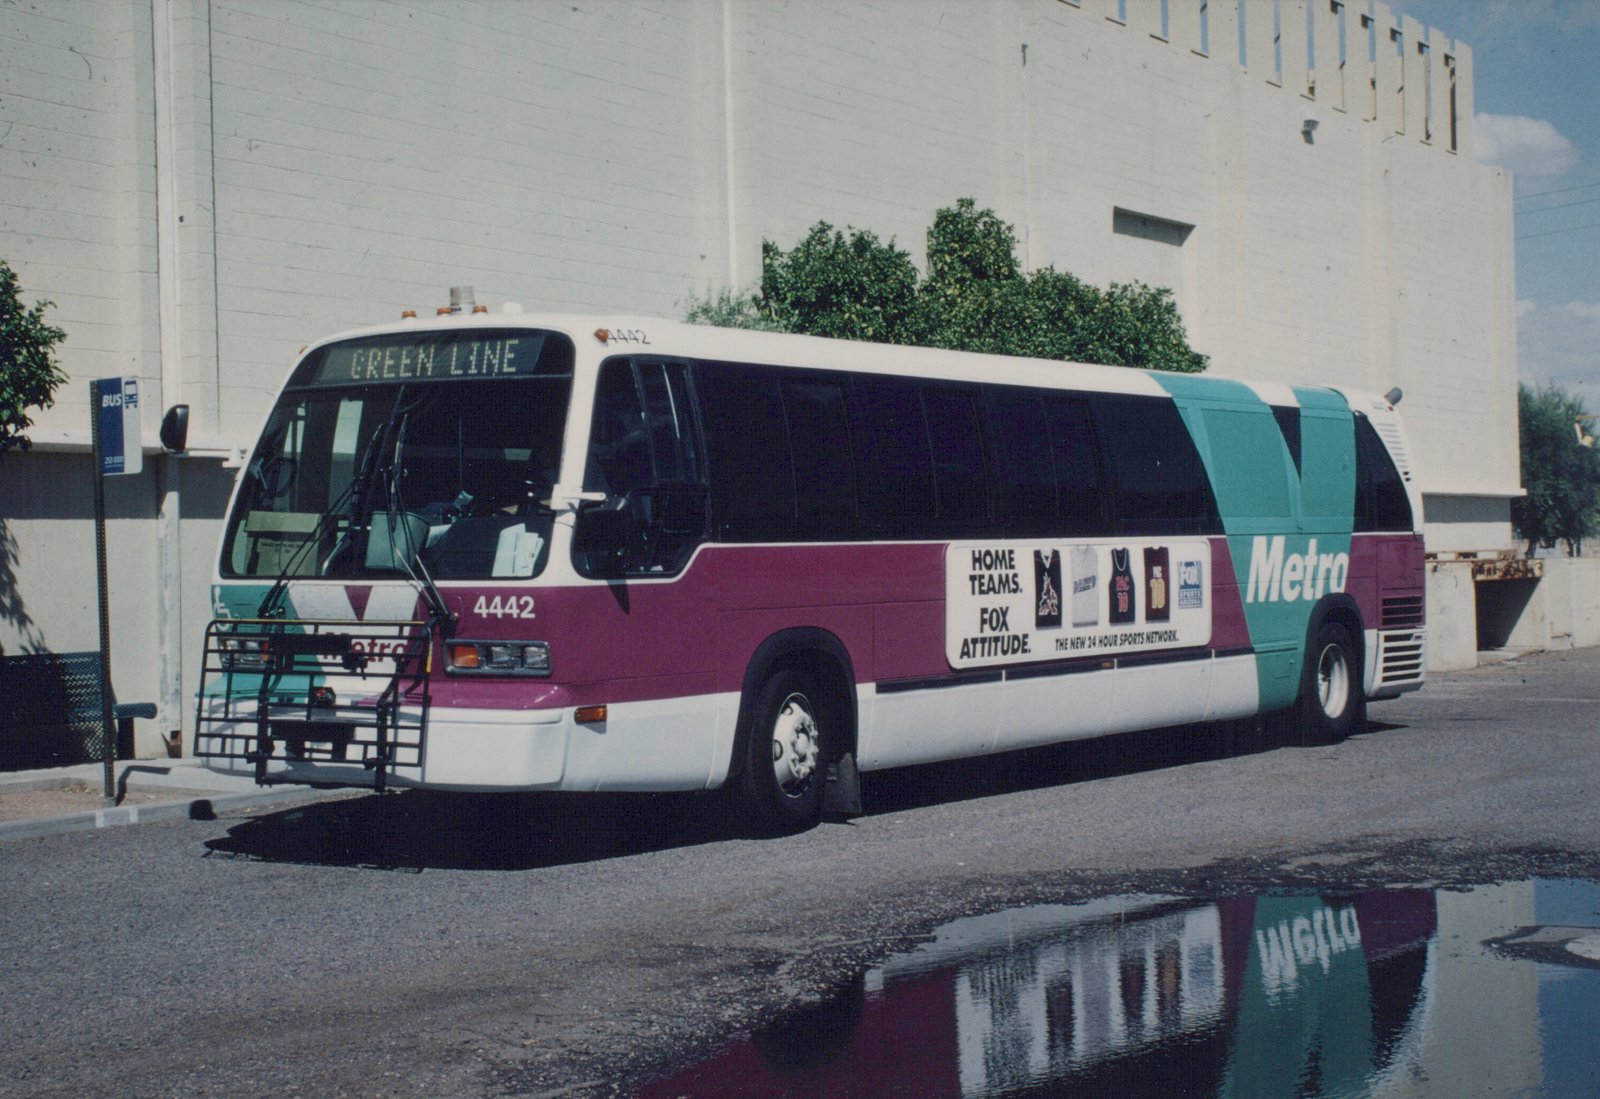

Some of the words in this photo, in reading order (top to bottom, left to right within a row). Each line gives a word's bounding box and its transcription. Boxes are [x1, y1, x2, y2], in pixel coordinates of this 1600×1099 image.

[351, 344, 435, 379] GREEN
[450, 339, 519, 376] LINE
[102, 394, 122, 408] BUS
[972, 549, 1015, 571] HOME
[1246, 535, 1349, 603] Metro
[969, 573, 1023, 595] TEAMS.
[1150, 578, 1165, 609] 10
[473, 595, 536, 619] 4442
[980, 606, 1009, 633] FOX
[324, 632, 409, 663] etro
[959, 634, 1031, 659] ATTITUDE.
[1055, 638, 1068, 651] THE
[1070, 636, 1086, 650] NEW
[1087, 636, 1096, 648] 24
[1098, 634, 1118, 648] HOUR
[1119, 632, 1145, 646] SPORTS
[1145, 629, 1180, 644] NETWORK.
